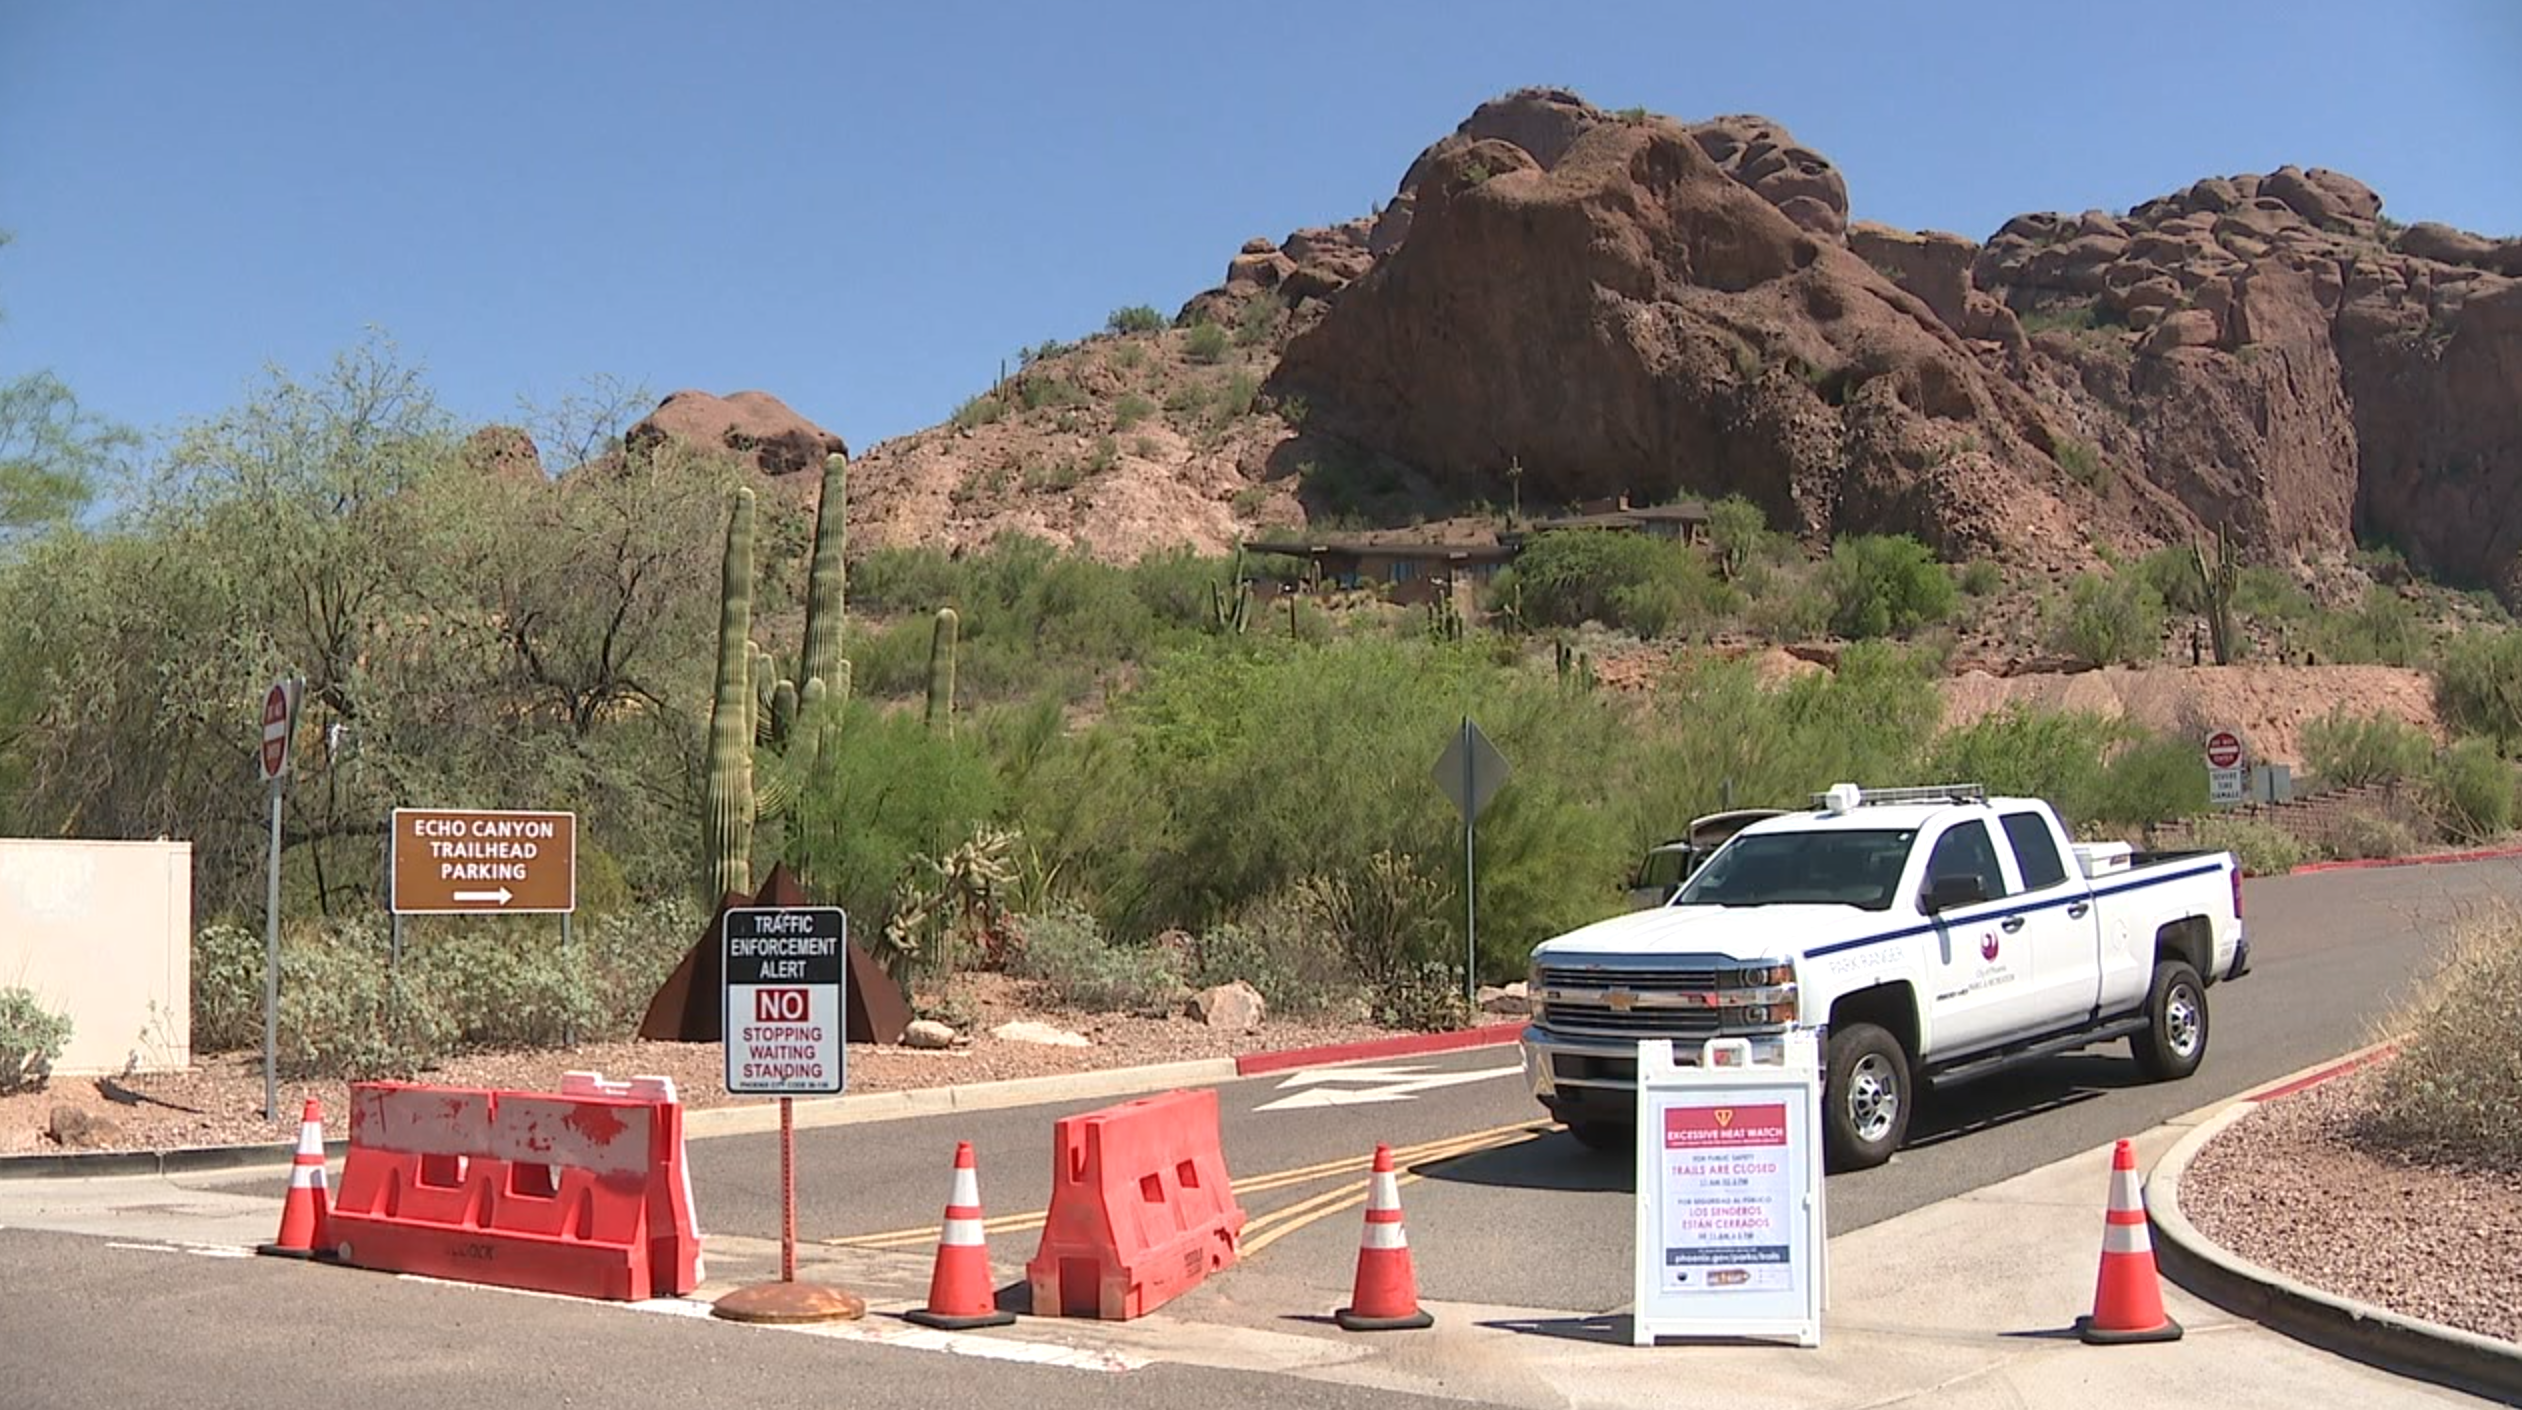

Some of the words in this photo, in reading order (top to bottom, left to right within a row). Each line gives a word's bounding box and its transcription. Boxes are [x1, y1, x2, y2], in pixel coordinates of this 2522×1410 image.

[414, 819, 466, 837] ECHO
[471, 820, 553, 838] CANYON
[430, 841, 538, 859] TRAILHEAD
[441, 863, 527, 880] PARKING
[754, 915, 813, 933] TRAFFIC
[731, 938, 837, 956] ENFORCEMENT
[760, 960, 806, 979] ALERT
[760, 991, 804, 1020] NO
[743, 1027, 822, 1041] STOPPING
[750, 1046, 815, 1060] WAITING
[743, 1063, 823, 1078] STANDING
[1667, 1130, 1718, 1141] EXCESSIVE
[1721, 1128, 1745, 1140] HEAT
[1747, 1127, 1783, 1138] WATCH
[1672, 1165, 1705, 1175] TRAILS
[1709, 1164, 1731, 1174] ARE
[1733, 1163, 1777, 1174] CLOSED
[1689, 1207, 1708, 1217] LOS
[1711, 1206, 1762, 1217] SENDEROS
[1716, 1218, 1769, 1229] CERRADOS
